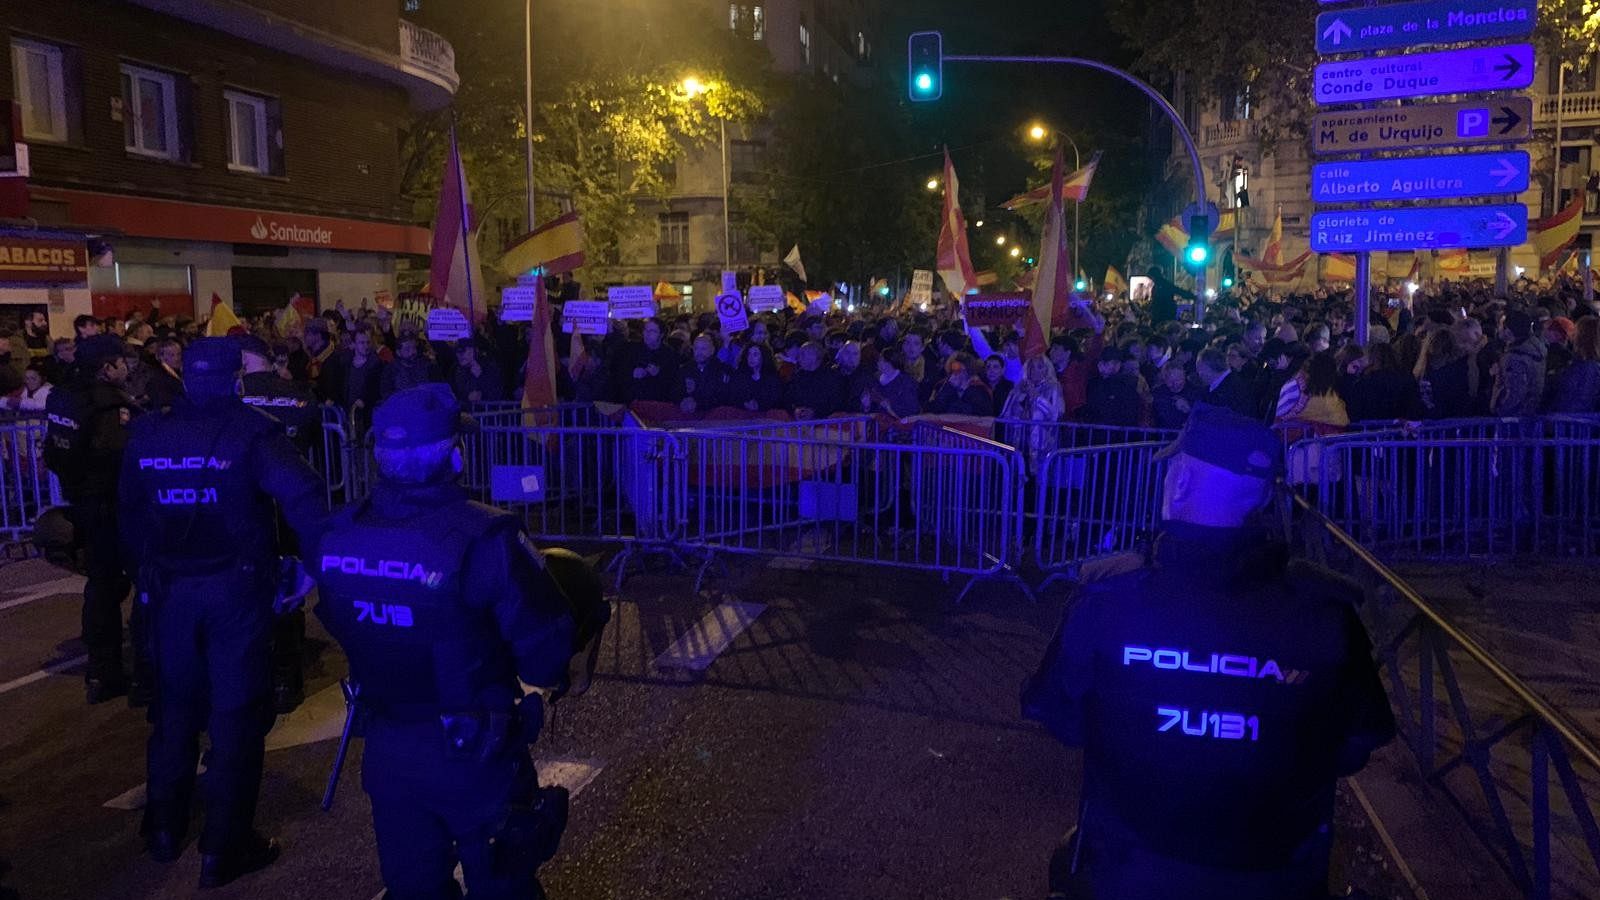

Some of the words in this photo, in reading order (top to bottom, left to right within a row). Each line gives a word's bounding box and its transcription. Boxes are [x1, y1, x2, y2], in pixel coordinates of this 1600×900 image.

[1360, 24, 1394, 38] plaza
[1402, 21, 1419, 32] de
[1426, 18, 1440, 29] la
[1448, 7, 1528, 27] Moncloa
[1322, 68, 1362, 79] centro
[1370, 61, 1423, 75] cultural
[1321, 80, 1373, 95] Conde
[1384, 76, 1439, 90] Duque
[1322, 113, 1408, 128] aparcamiento
[1462, 112, 1483, 136] P
[1320, 130, 1339, 145] M.
[1348, 130, 1369, 143] de
[1379, 125, 1444, 142] Urquijo
[1320, 168, 1350, 179] calle
[1320, 180, 1380, 195] Alberto
[1391, 177, 1464, 193] Aguilera
[1318, 216, 1369, 230] glorieta
[1378, 215, 1396, 225] de
[269, 221, 333, 244] Santander
[1364, 228, 1435, 243] Jiménez
[242, 396, 298, 408] POLICIA
[139, 456, 219, 470] POLICIA
[321, 555, 427, 585] POLICIA
[352, 600, 414, 628] 7U13
[1123, 647, 1285, 682] POLICIA
[1157, 707, 1260, 742] 7U131
